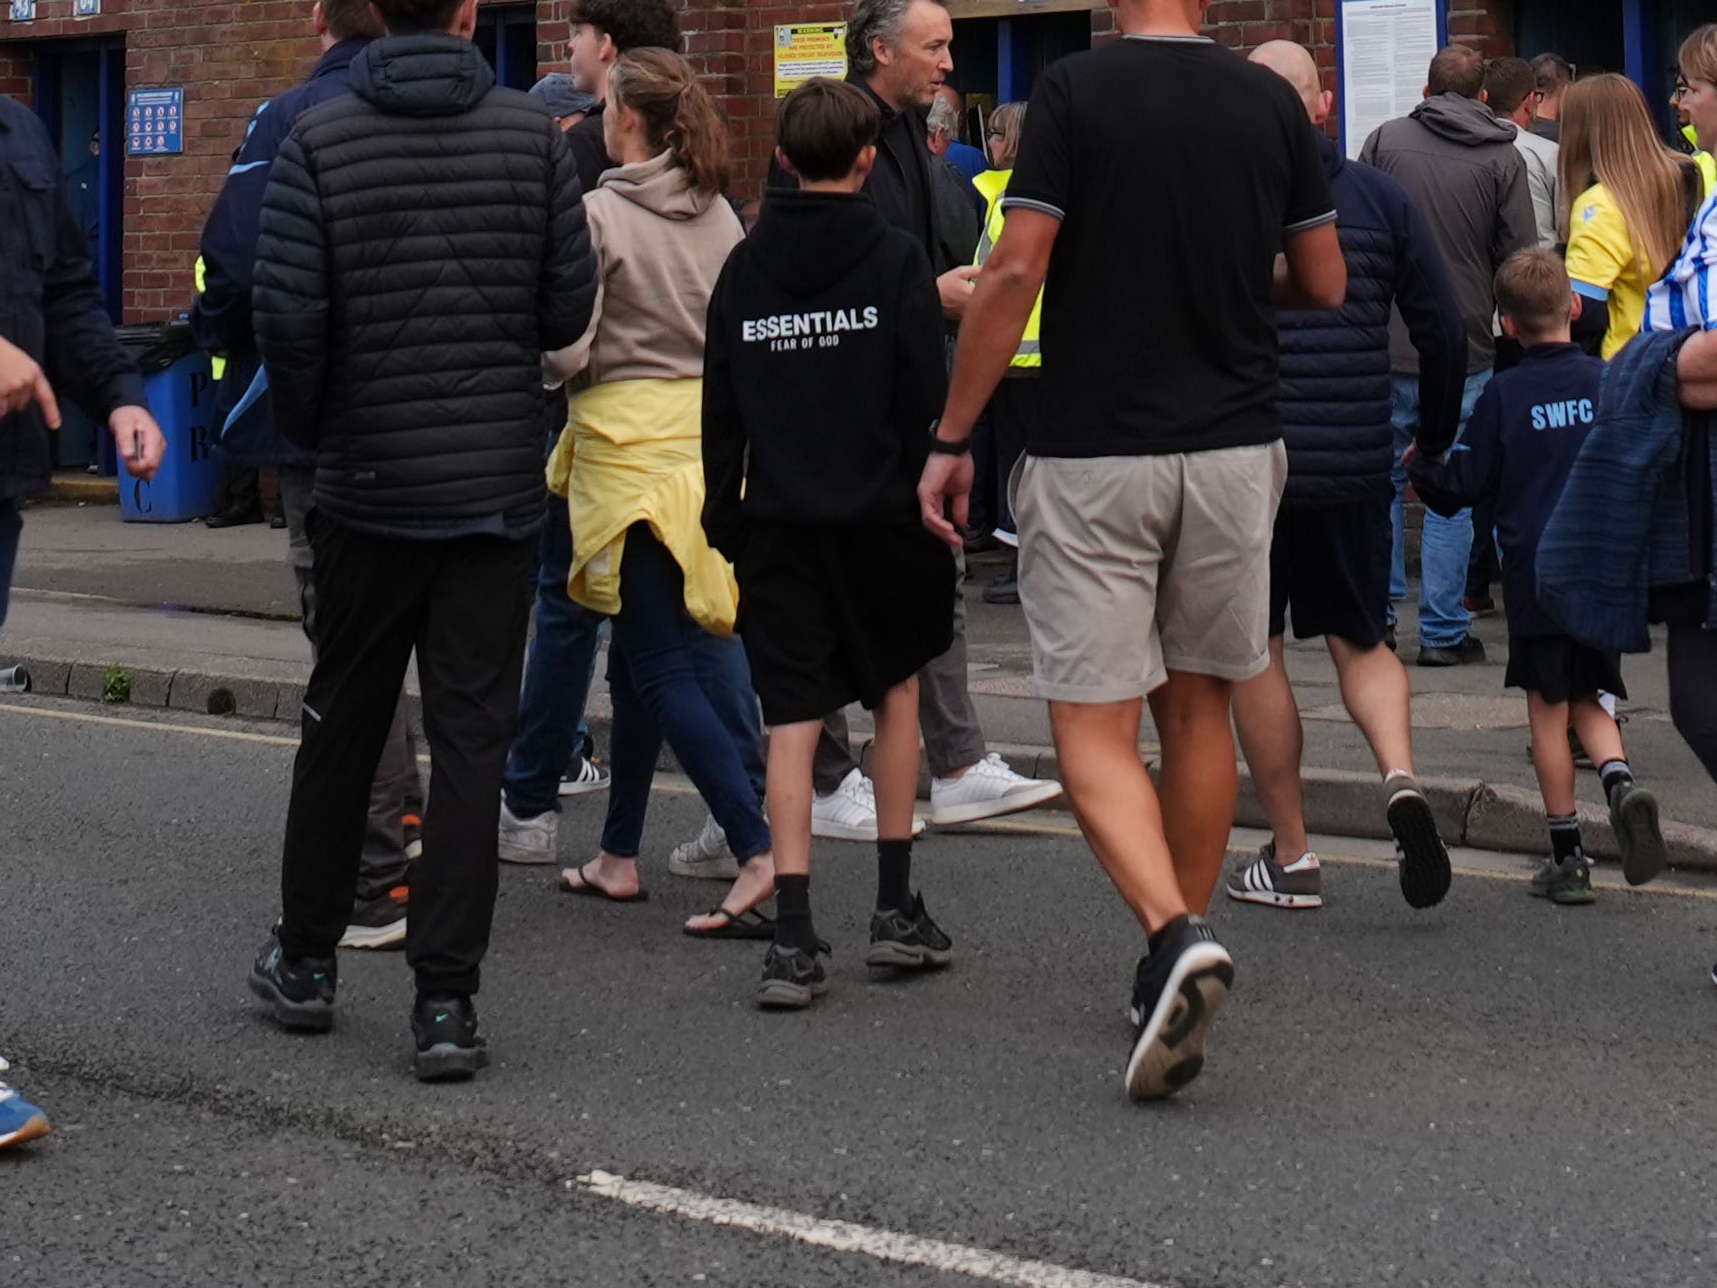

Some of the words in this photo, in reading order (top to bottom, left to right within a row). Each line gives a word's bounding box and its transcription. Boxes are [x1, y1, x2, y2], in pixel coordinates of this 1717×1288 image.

[742, 306, 878, 342] ESSENTIALS
[771, 337, 796, 352] FEAR
[801, 336, 813, 349] OF
[819, 335, 839, 347] GOD
[1530, 398, 1594, 430] SWFC
